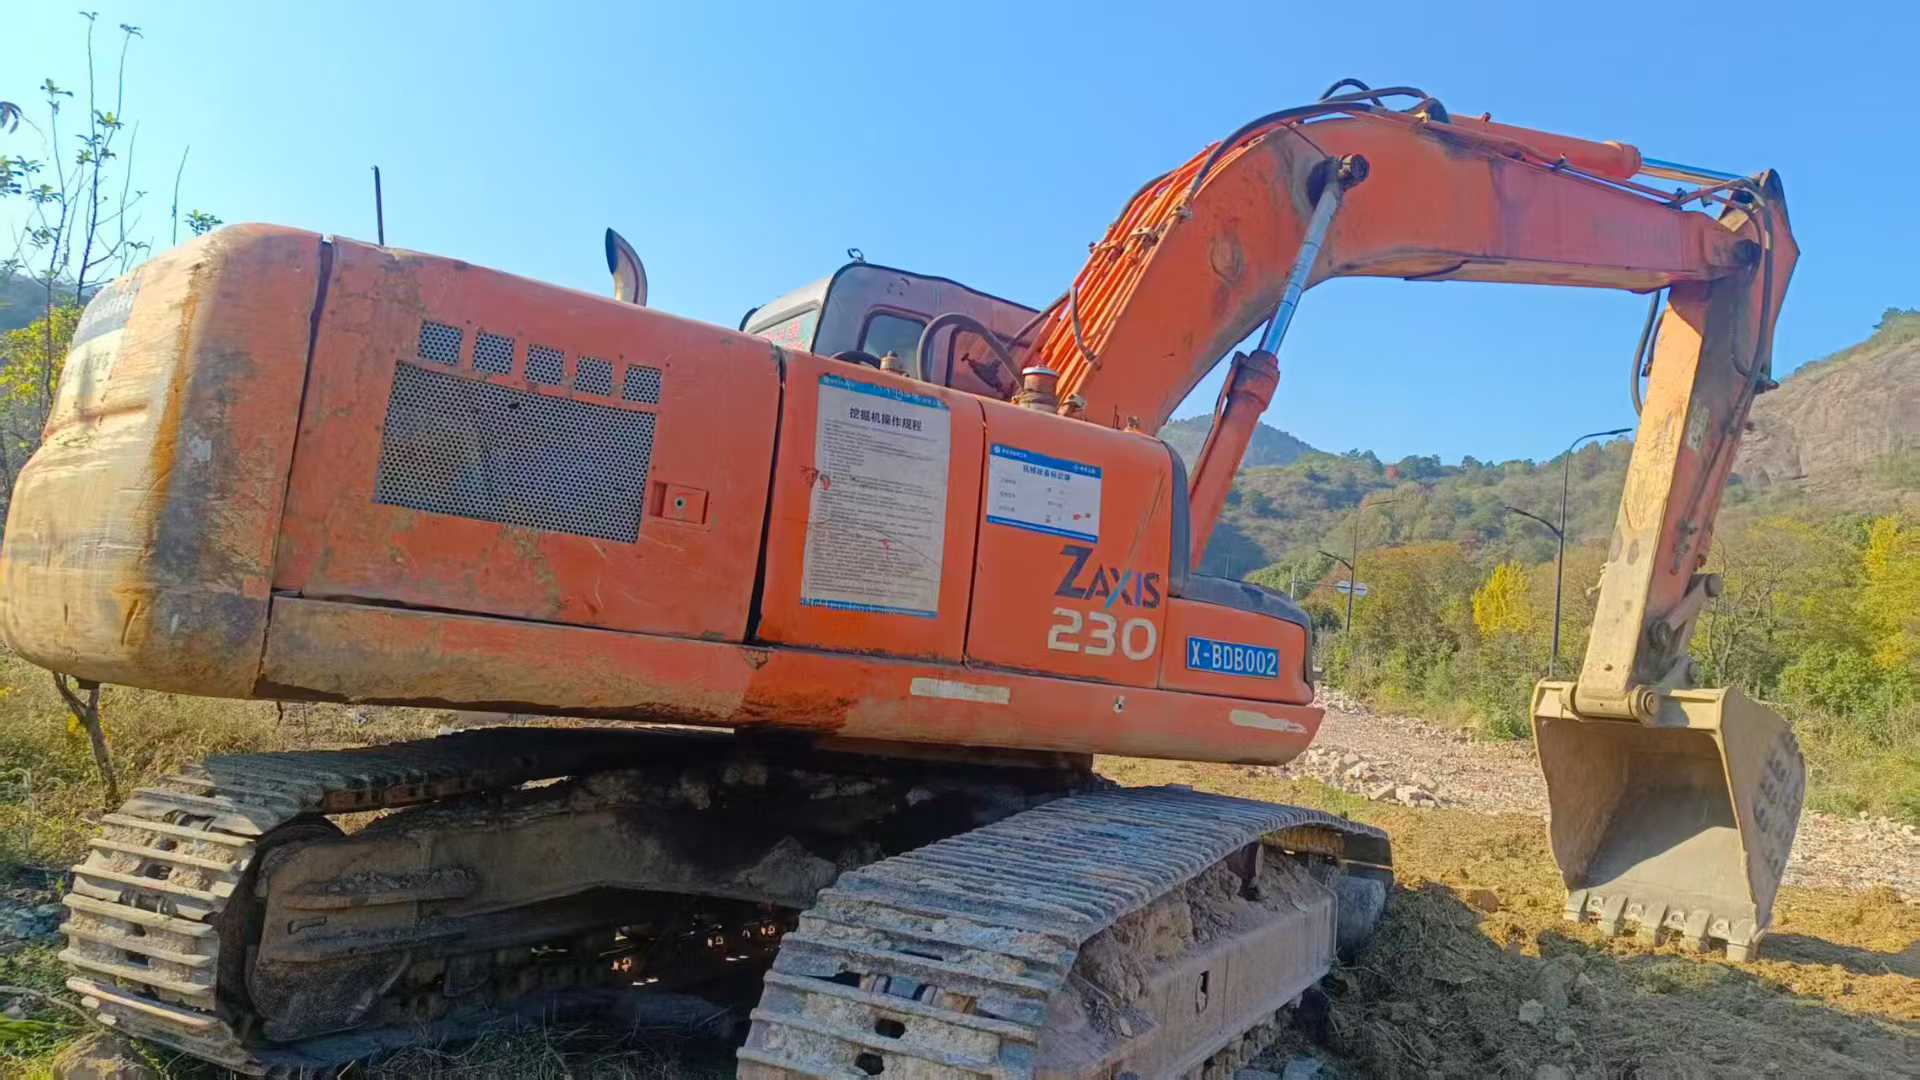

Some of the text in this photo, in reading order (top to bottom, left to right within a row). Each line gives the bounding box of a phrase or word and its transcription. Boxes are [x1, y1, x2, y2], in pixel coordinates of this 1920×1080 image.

[849, 407, 922, 432] 挖掘机操作规程
[1055, 544, 1160, 609] ZAXIS
[1047, 607, 1157, 661] 230
[1191, 640, 1277, 676] X-BDB002
